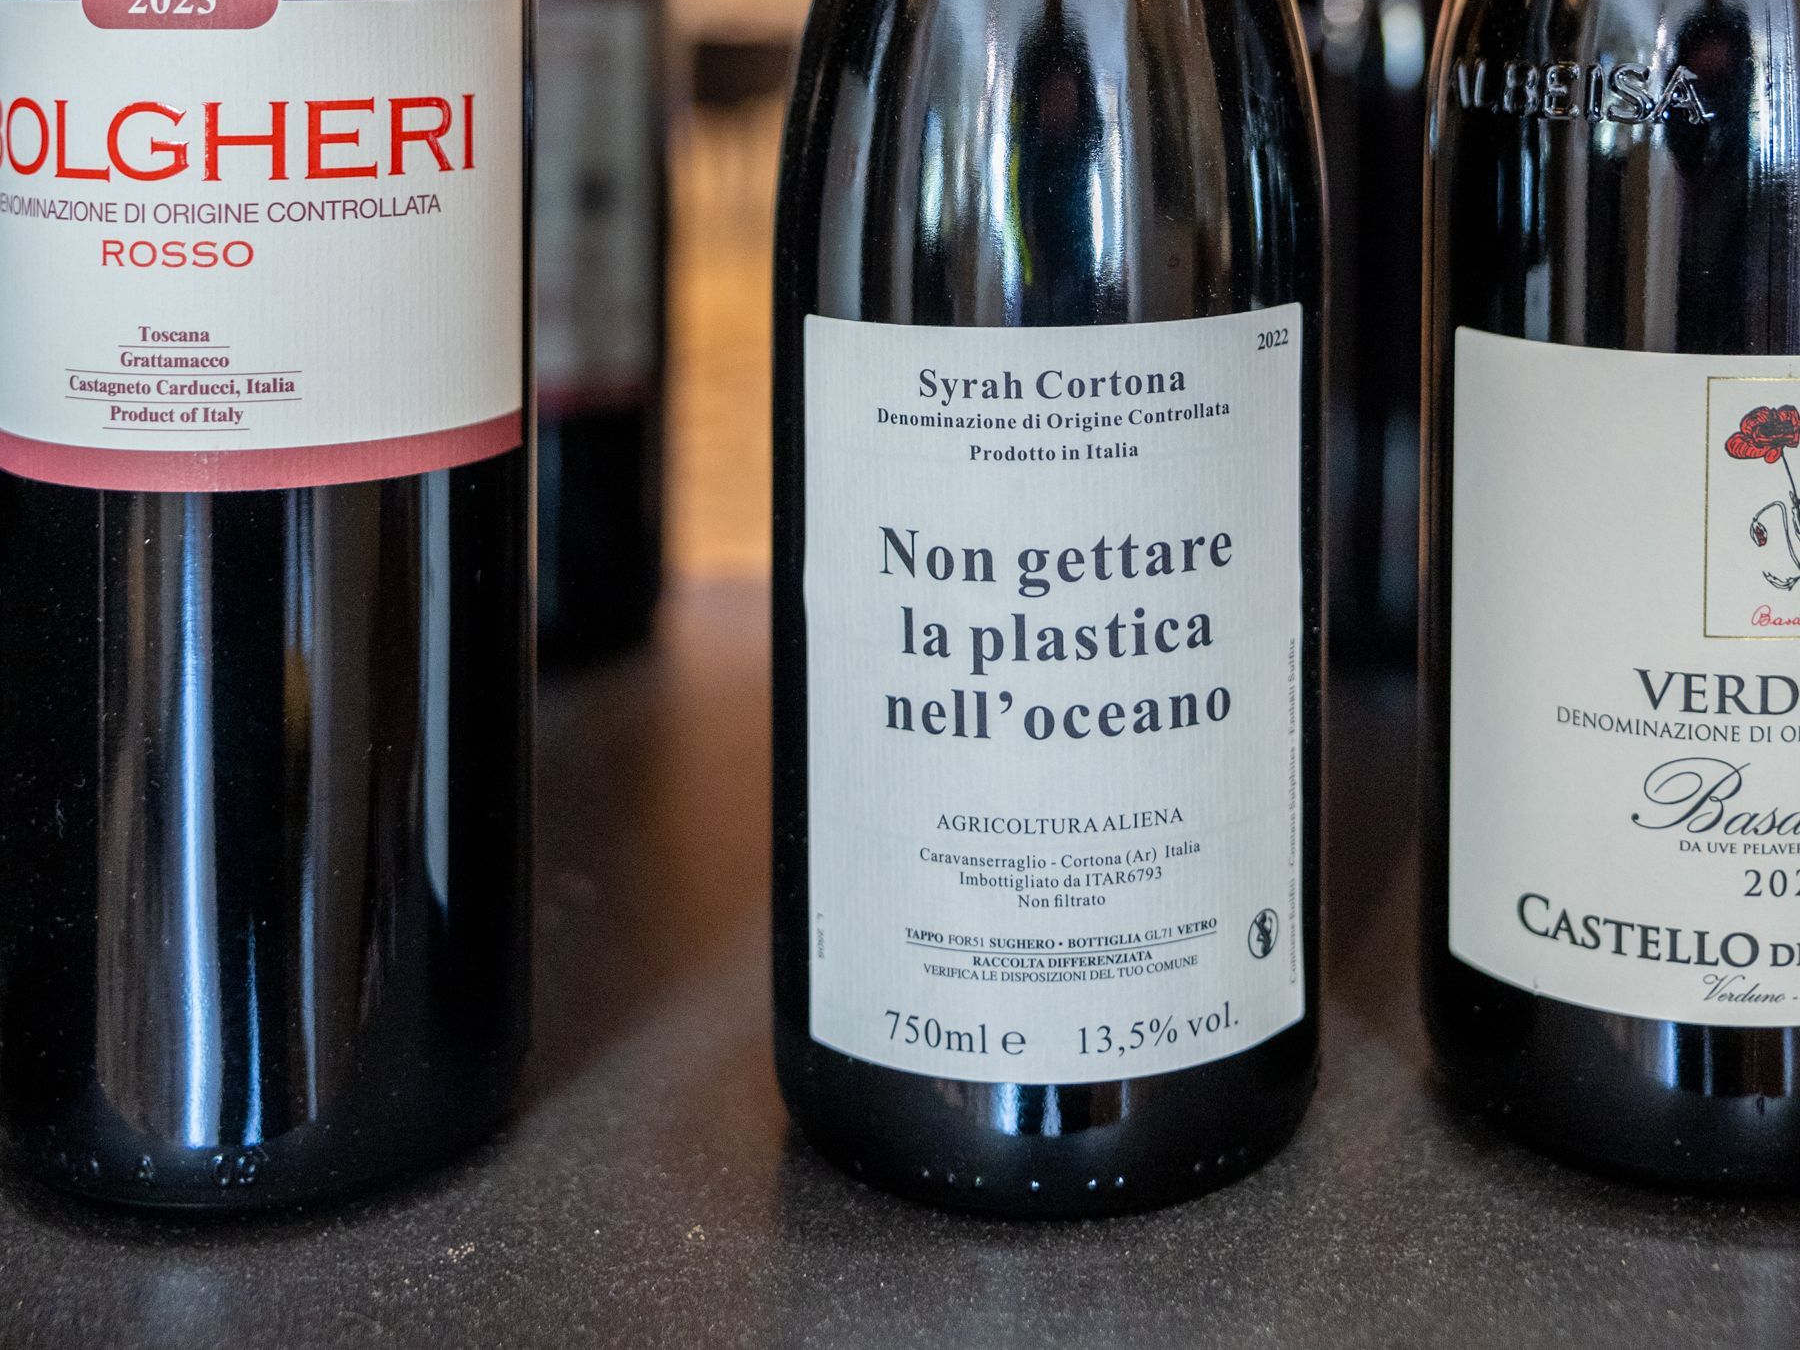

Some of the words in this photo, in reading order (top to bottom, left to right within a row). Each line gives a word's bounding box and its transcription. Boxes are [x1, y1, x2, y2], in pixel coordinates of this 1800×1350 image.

[0, 93, 476, 183] OLGHERI
[124, 202, 147, 223] DI
[153, 201, 260, 224] ORIGINE
[267, 193, 442, 223] CONTROLLATA
[101, 239, 255, 269] ROSSO
[138, 325, 211, 344] Toscana
[1257, 327, 1290, 352] 2022
[120, 351, 230, 369] Grattamacco
[69, 374, 151, 396] Castagneto
[156, 379, 241, 398] Carducci,
[246, 377, 296, 394] Italia
[918, 368, 1024, 407] Syrah
[1036, 369, 1187, 400] Cortona
[110, 406, 177, 424] Product
[180, 406, 199, 424] of
[202, 406, 244, 426] Italy
[877, 407, 1017, 430] Denominazione
[1022, 412, 1042, 430] di
[1046, 411, 1123, 433] Origine
[1128, 401, 1231, 426] Controllata
[969, 444, 1056, 462] Prodotto
[1061, 444, 1080, 461] in
[1085, 443, 1139, 460] Italia
[878, 525, 996, 583] Non
[1016, 529, 1234, 599] gettare
[901, 606, 951, 658] la
[968, 607, 1214, 677] plastica
[1633, 667, 1800, 717] VERD
[1556, 705, 1742, 744] DENOMINAZIONE
[1749, 725, 1772, 744] DI
[1780, 725, 1800, 744] O
[936, 813, 1098, 835] AGRICOLTURA
[1102, 806, 1185, 832] ALIENA
[919, 846, 1047, 871] Caravanserraglio
[1061, 850, 1122, 870] Cortona
[1126, 847, 1158, 866] (Ar)
[1164, 839, 1201, 859] Italia
[1680, 839, 1702, 853] DA
[1707, 841, 1738, 855] UVE
[959, 871, 1060, 892] Imbottigliato
[1063, 874, 1081, 889] da
[1084, 866, 1163, 888] ITAR6793
[1017, 893, 1050, 908] Non
[1053, 892, 1106, 909] filtrato
[905, 927, 944, 944] TAPPO
[989, 937, 1055, 950] SUGHERO
[1067, 933, 1141, 949] BOTTIGLIA
[1177, 917, 1218, 936] VETRO
[1516, 891, 1761, 970] CASTELLO
[923, 963, 979, 981] VERIFICA
[981, 970, 998, 982] LE
[1000, 970, 1086, 983] DISPOSIZIONI
[1089, 968, 1115, 980] DEL
[1116, 965, 1144, 978] TUO
[1146, 954, 1199, 974] COMUNE
[972, 955, 1046, 969] RACCOLTA
[1047, 950, 1153, 969] DIFFERENZIATA
[1702, 973, 1786, 1009] Verduno
[884, 1009, 990, 1056] 750ml
[1077, 1014, 1179, 1058] 13,5%
[1187, 1001, 1240, 1039] vol.
